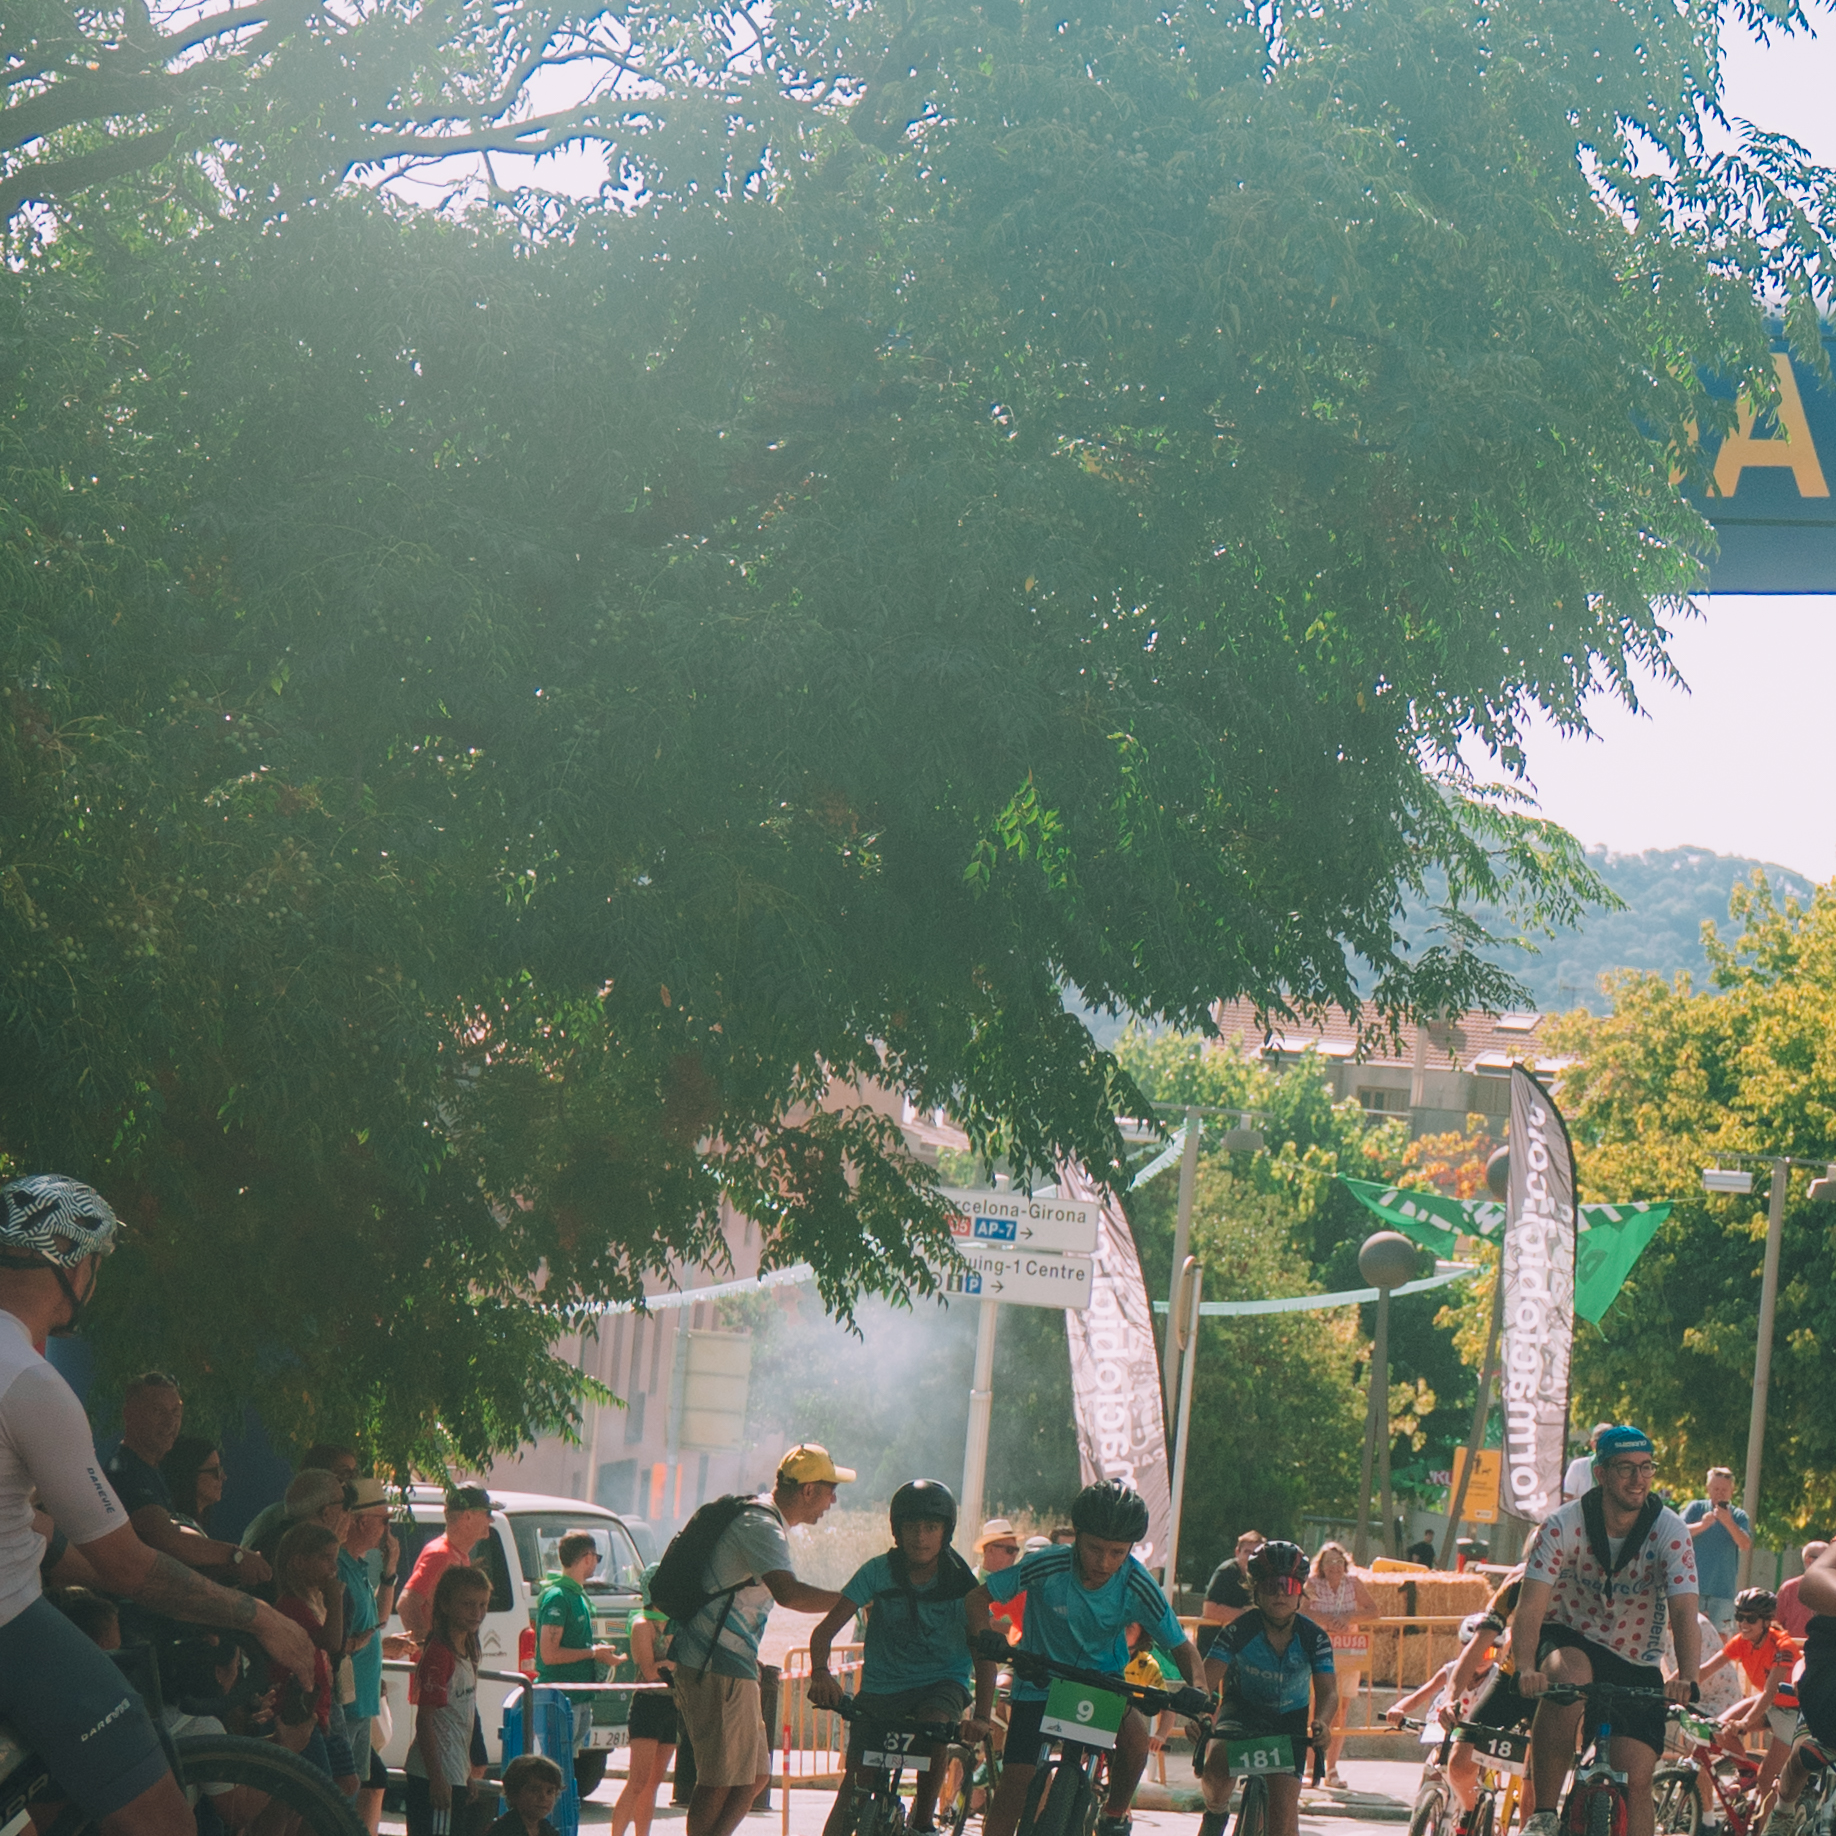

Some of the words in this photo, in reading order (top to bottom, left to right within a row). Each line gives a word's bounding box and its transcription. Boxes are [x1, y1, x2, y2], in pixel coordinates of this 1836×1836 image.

[953, 1198, 1087, 1224] rcelona-Girona
[977, 1222, 1015, 1239] AP-7
[1026, 1260, 1085, 1281] Centre
[87, 1467, 116, 1514] DAREVIE
[1331, 1634, 1367, 1648] AUSA
[1075, 1700, 1094, 1722] 9
[1239, 1747, 1281, 1769] 181
[1488, 1738, 1512, 1758] 18
